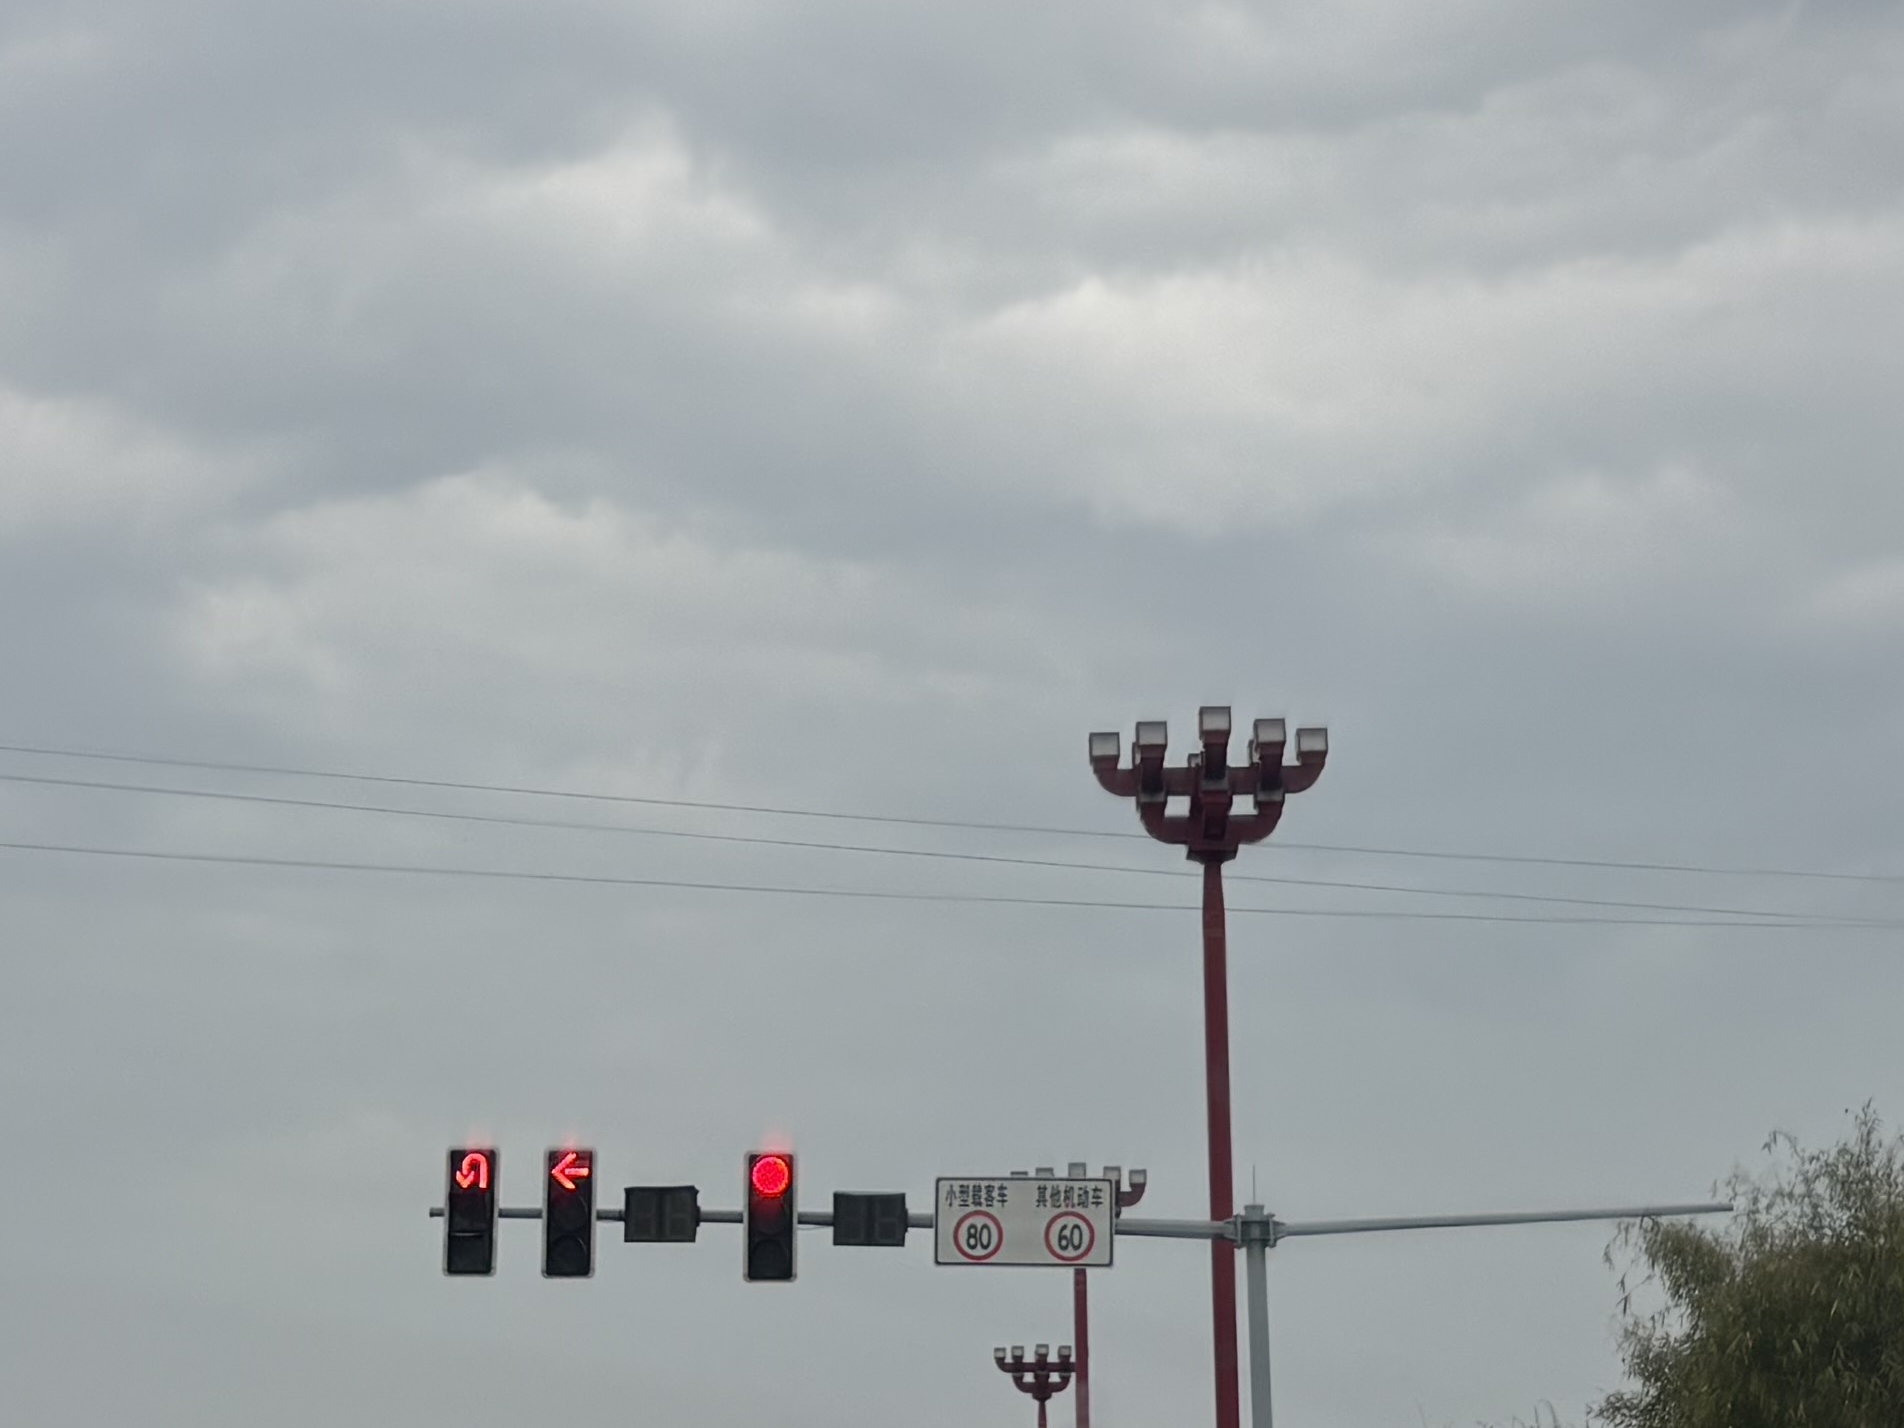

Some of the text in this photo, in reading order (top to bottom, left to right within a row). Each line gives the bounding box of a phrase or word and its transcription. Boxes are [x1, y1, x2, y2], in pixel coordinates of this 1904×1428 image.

[945, 1183, 1008, 1208] 小型载客车
[1036, 1184, 1103, 1209] 其他机动车
[966, 1223, 992, 1250] 80
[1057, 1224, 1083, 1251] 60
